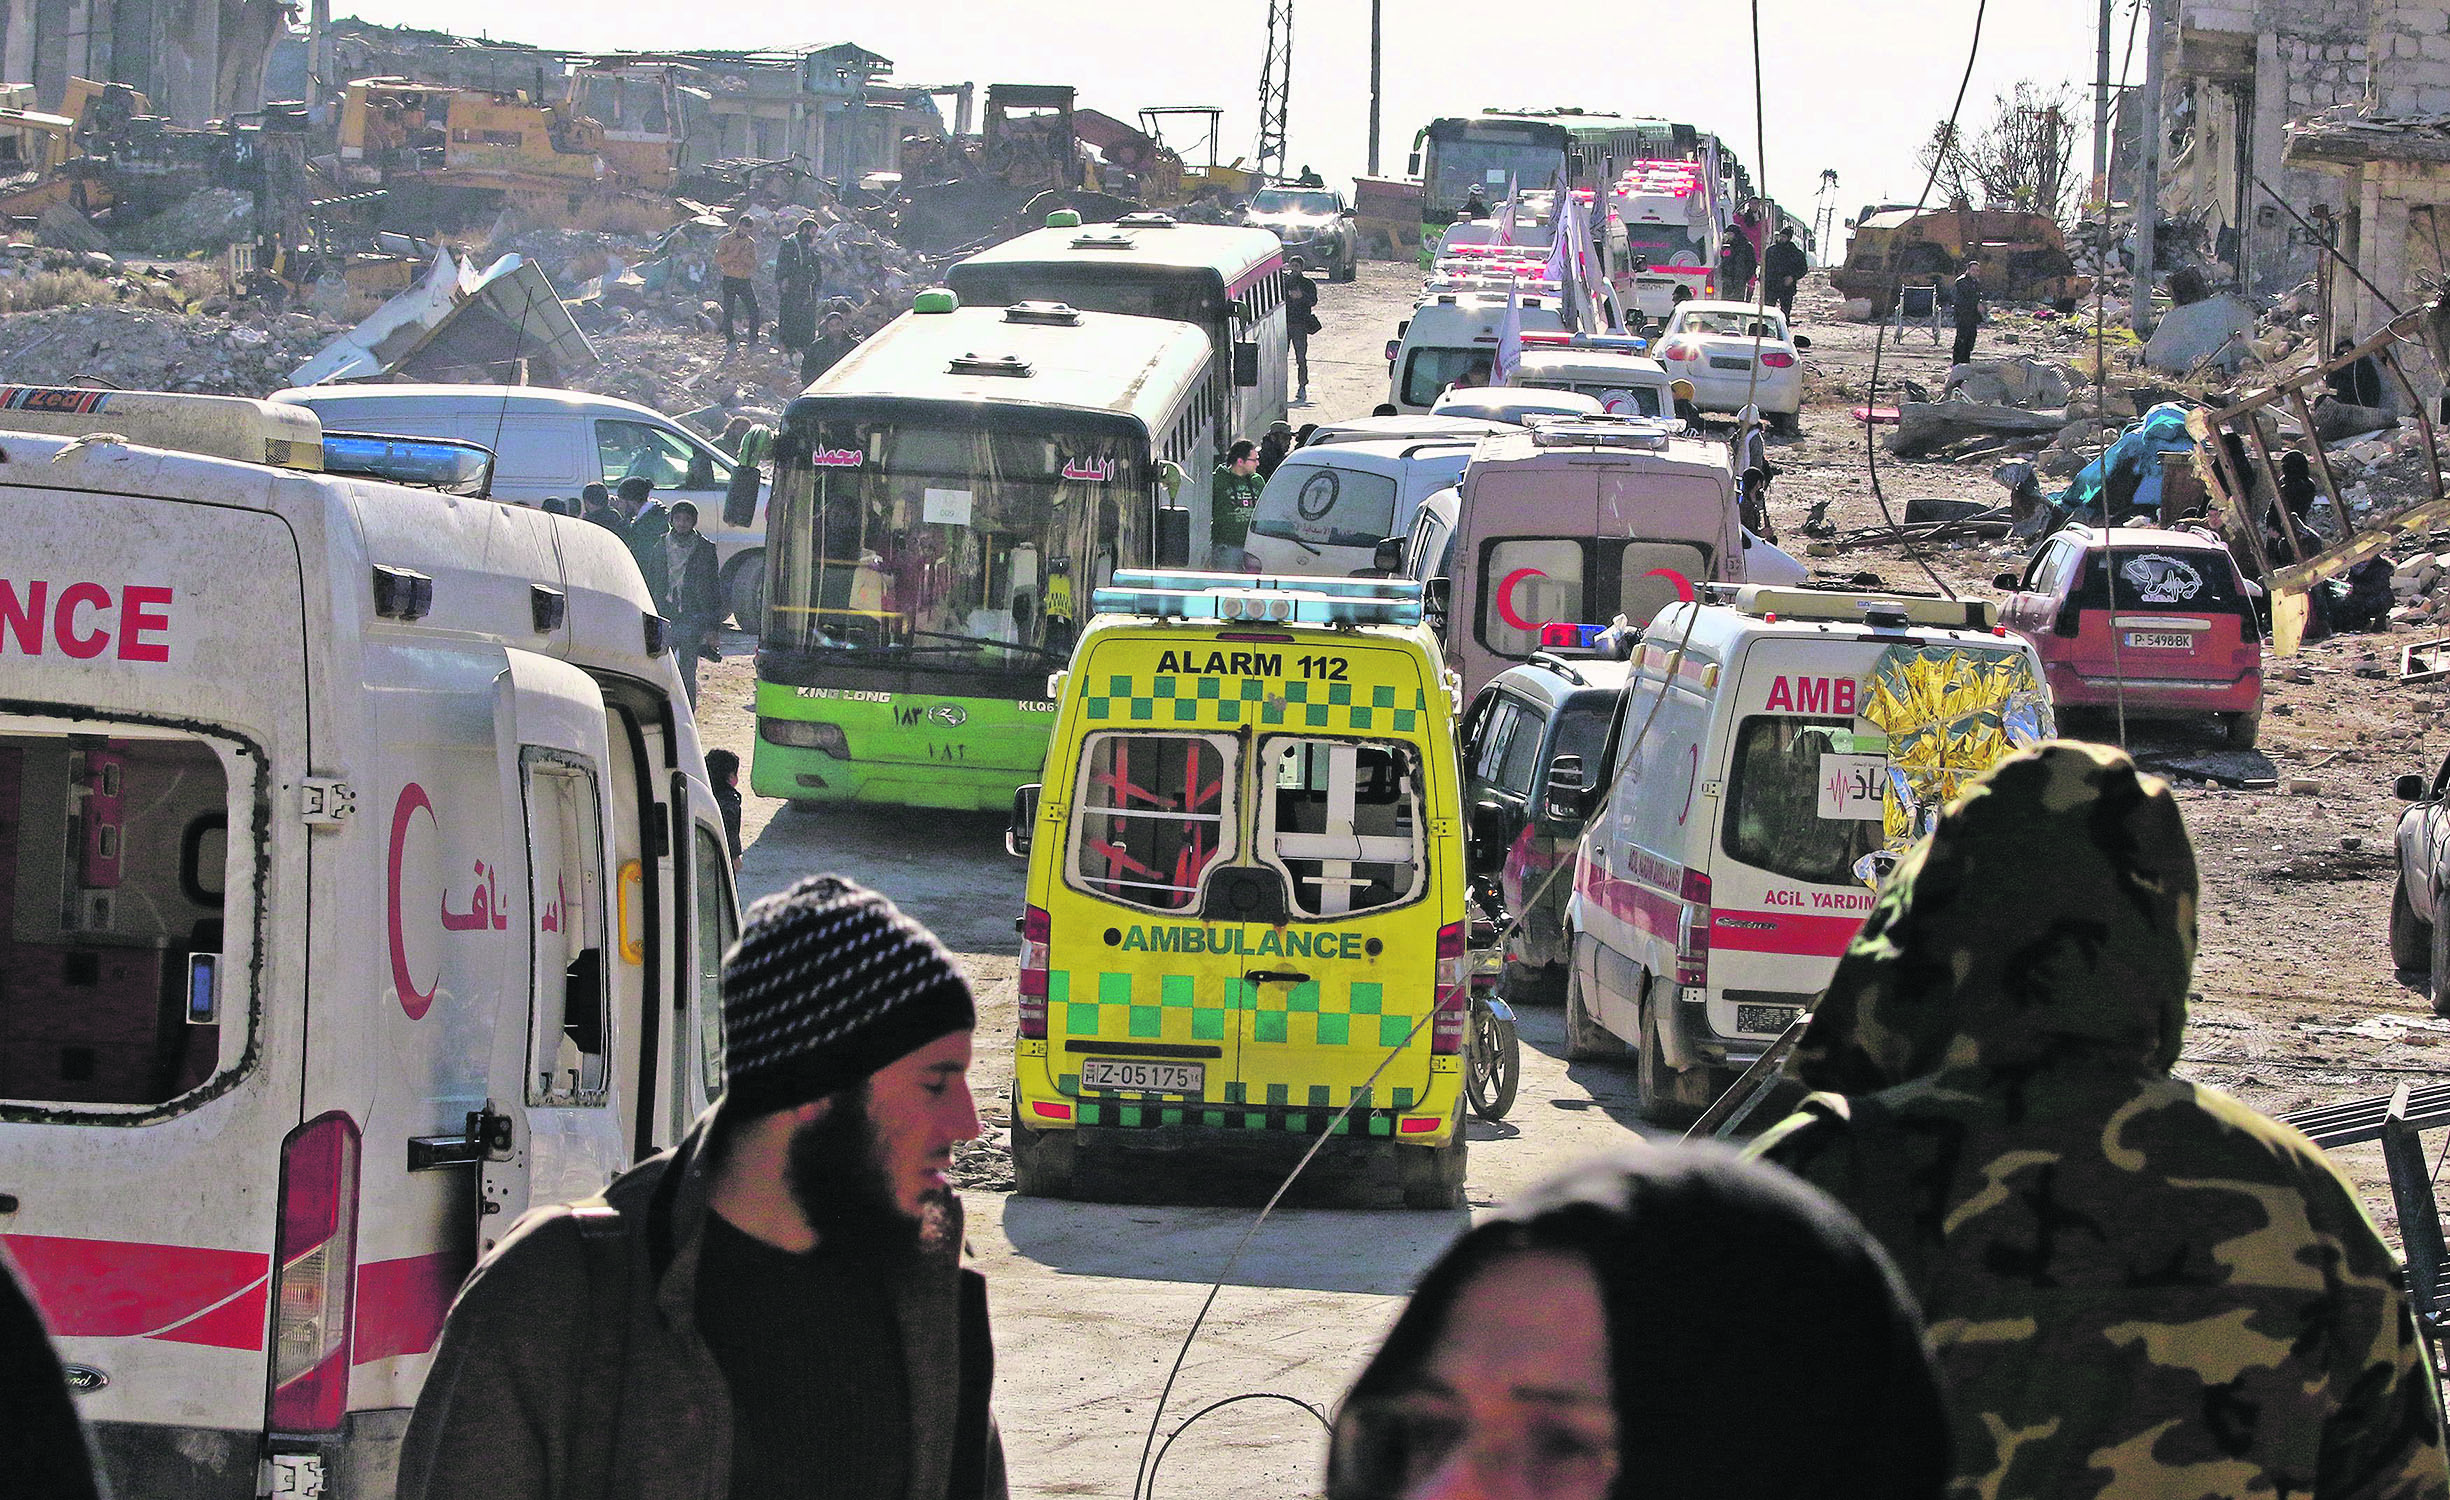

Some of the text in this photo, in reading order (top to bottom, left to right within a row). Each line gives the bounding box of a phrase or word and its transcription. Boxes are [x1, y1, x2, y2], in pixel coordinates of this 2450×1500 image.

[813, 443, 863, 467] محمد
[1061, 456, 1114, 481] الله
[1156, 650, 1348, 681] ALARM 112
[797, 686, 891, 703] KING LONG
[1121, 925, 1362, 959] AMBULANCE
[1099, 1064, 1188, 1087] Z-05175
